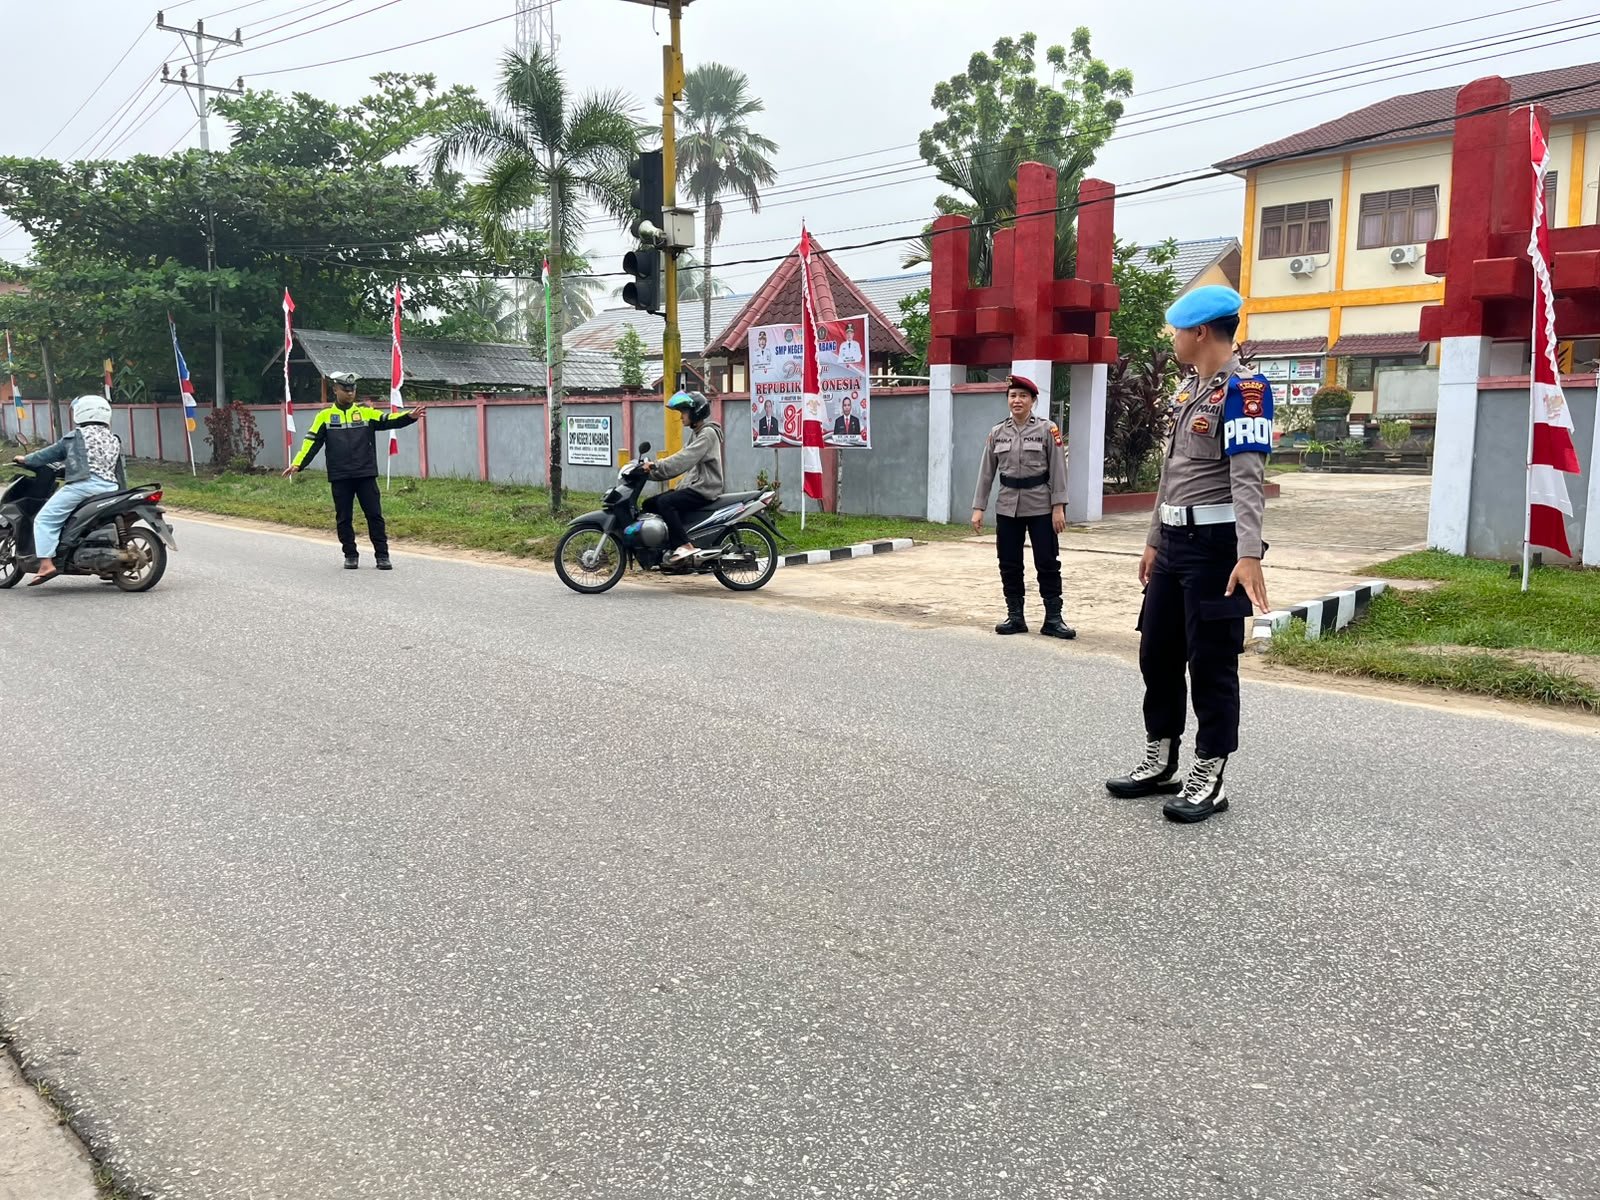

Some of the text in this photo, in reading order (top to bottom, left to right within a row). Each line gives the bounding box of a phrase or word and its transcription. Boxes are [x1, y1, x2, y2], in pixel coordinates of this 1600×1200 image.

[775, 341, 837, 355] SMP NEGER ABANG
[756, 379, 861, 394] REPUBLIK ONESIA
[1196, 404, 1220, 415] POLRI
